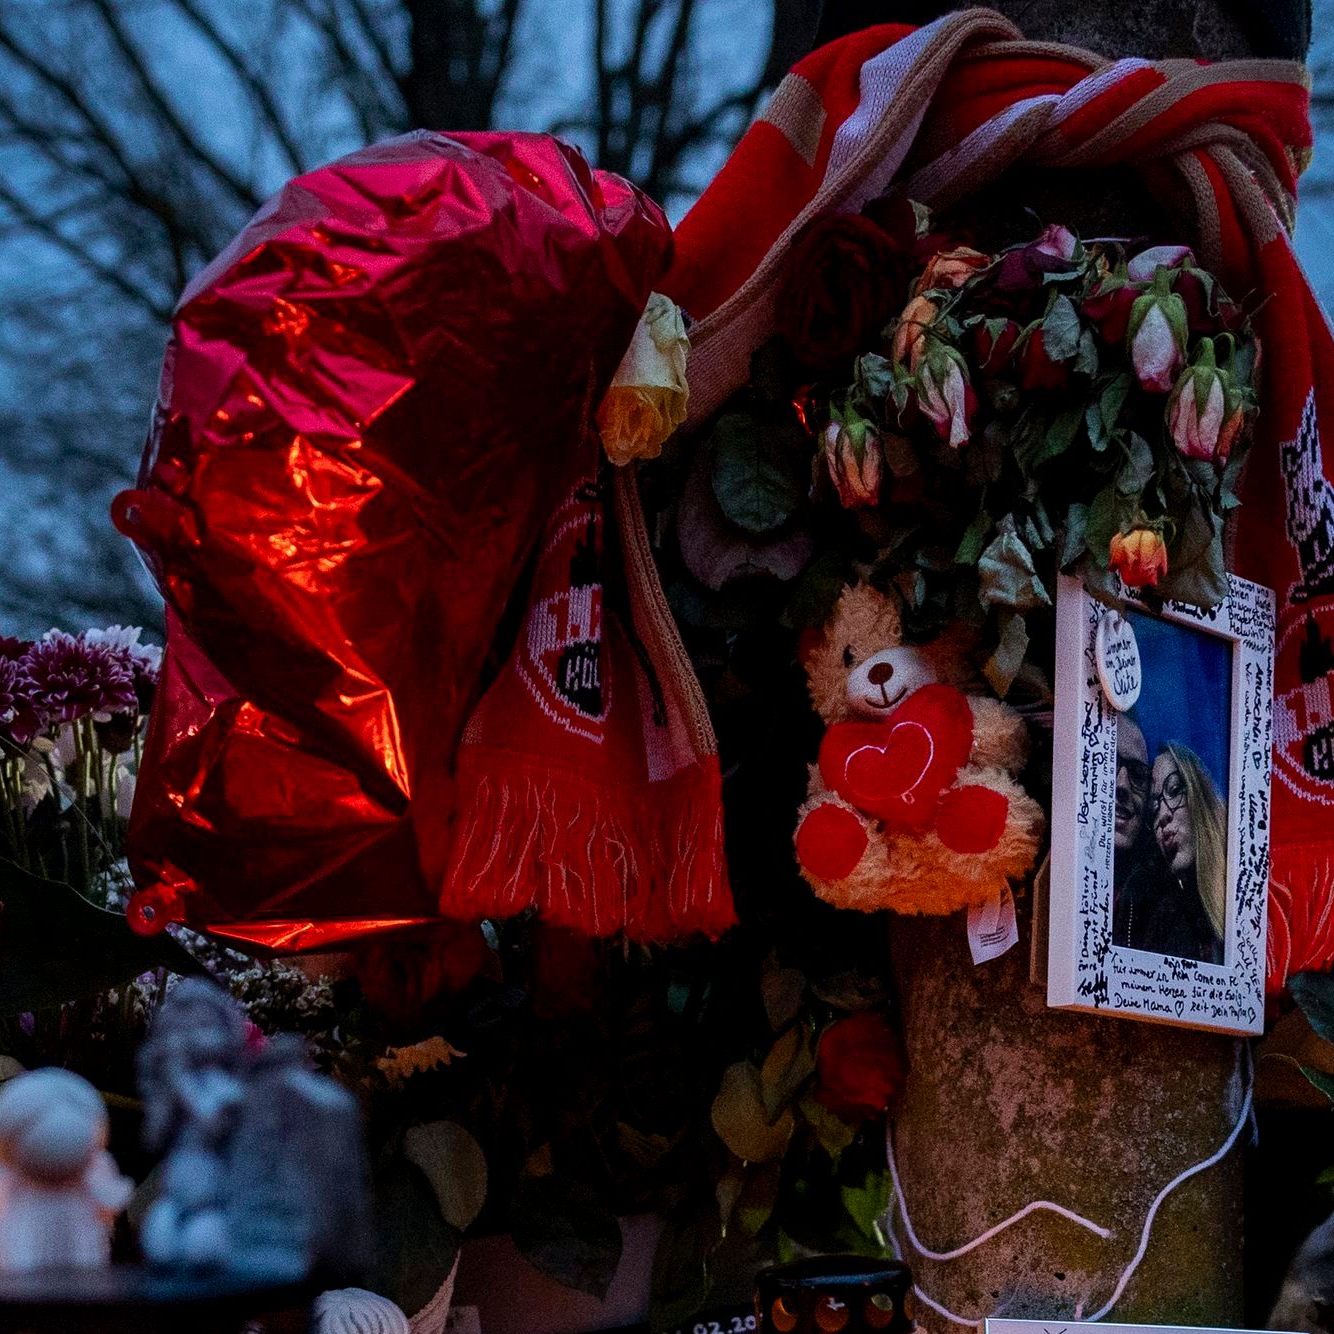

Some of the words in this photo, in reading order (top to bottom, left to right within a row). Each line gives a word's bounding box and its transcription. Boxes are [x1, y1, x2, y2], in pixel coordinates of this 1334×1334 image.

[565, 645, 602, 692] KÖL
[1114, 992, 1141, 1009] Deine
[1143, 998, 1172, 1013] Mama
